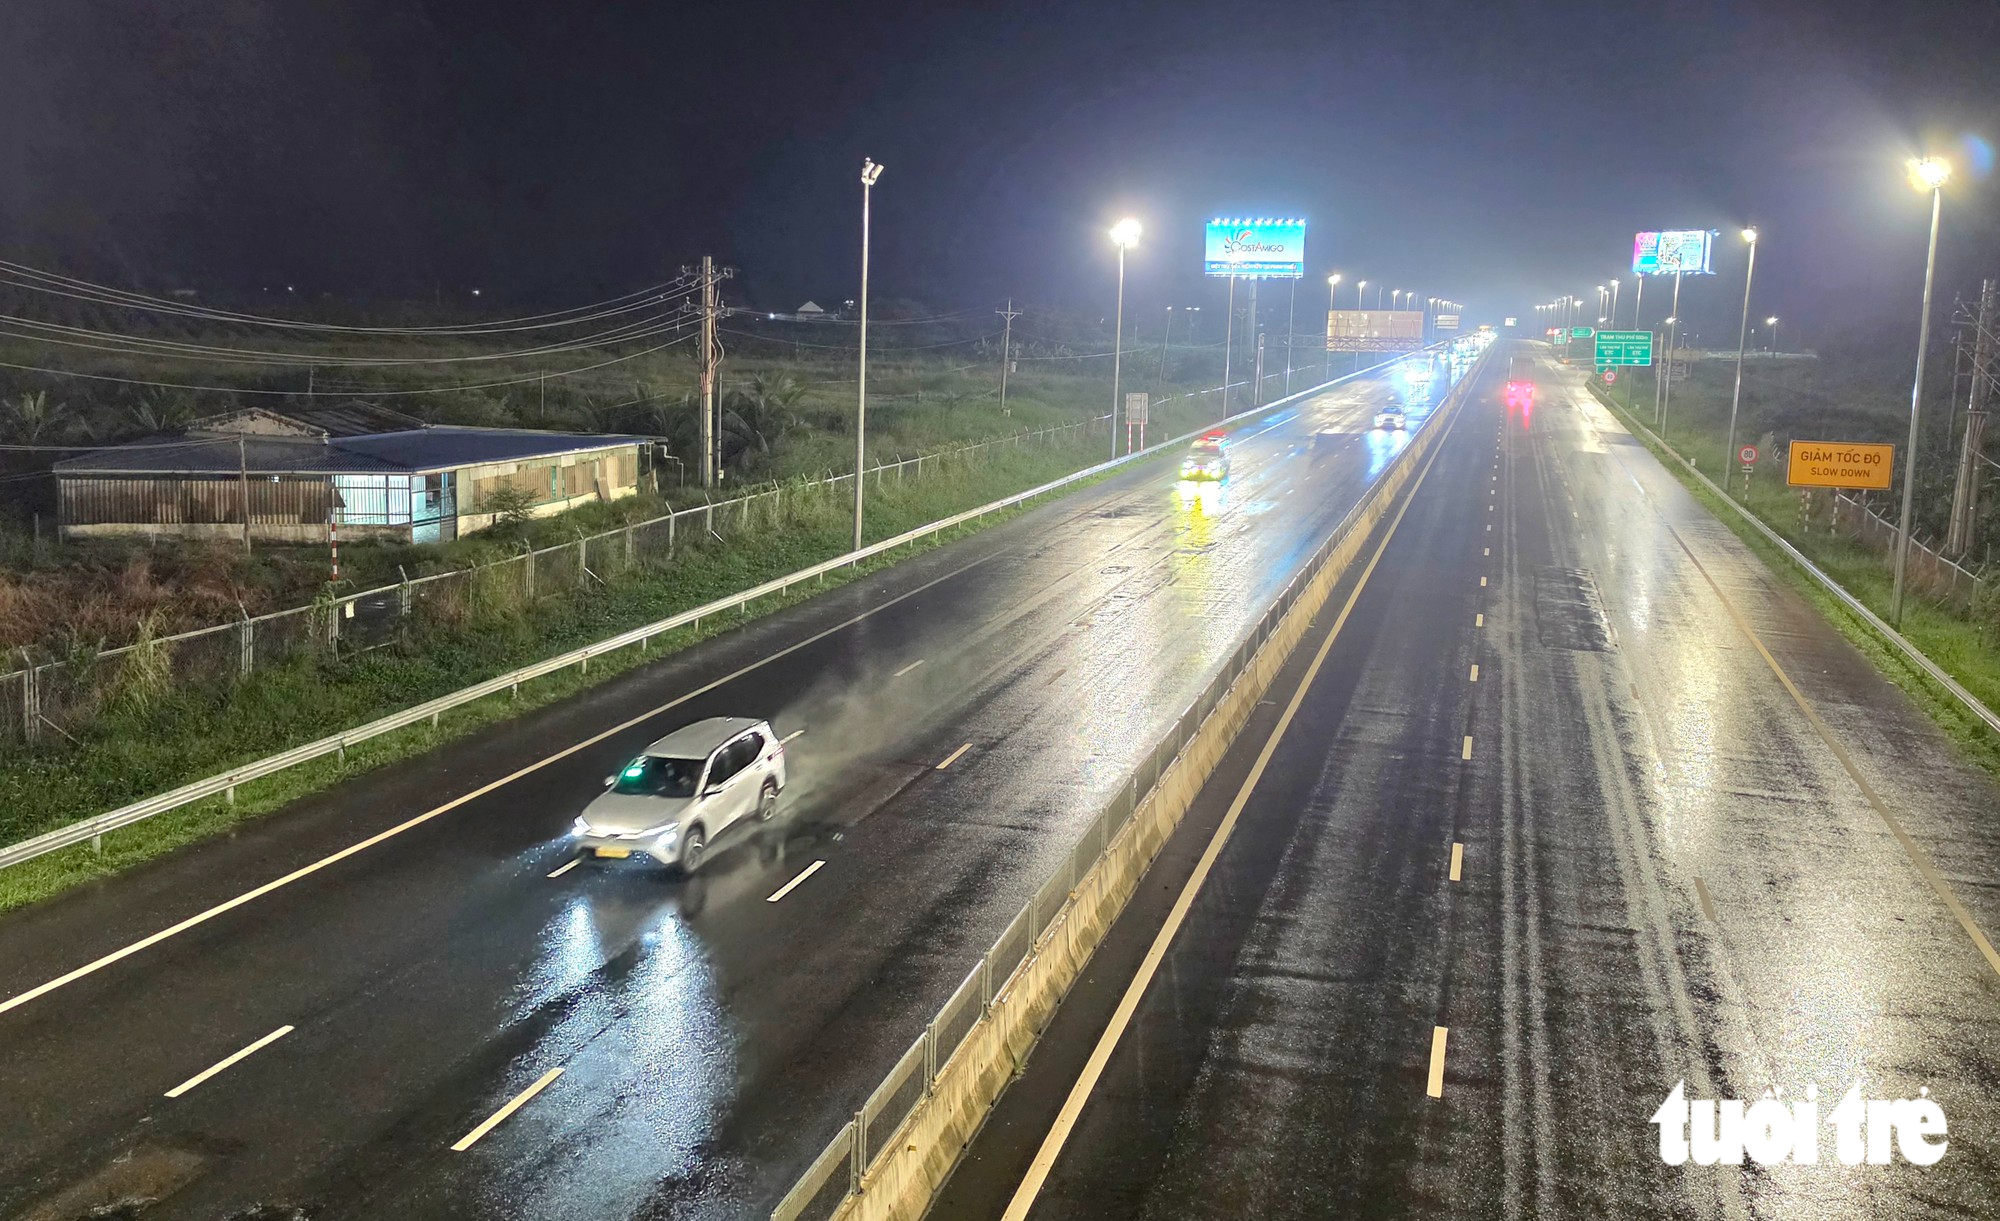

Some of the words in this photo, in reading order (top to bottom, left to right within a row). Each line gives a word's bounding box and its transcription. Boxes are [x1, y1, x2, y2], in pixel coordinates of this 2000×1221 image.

[1744, 450, 1753, 458] 80
[1800, 448, 1833, 463] GIẢM
[1836, 448, 1861, 464] TỐC
[1863, 452, 1881, 467] ĐỘ
[1810, 467, 1839, 477] SLOW
[1840, 468, 1870, 478] DOWN
